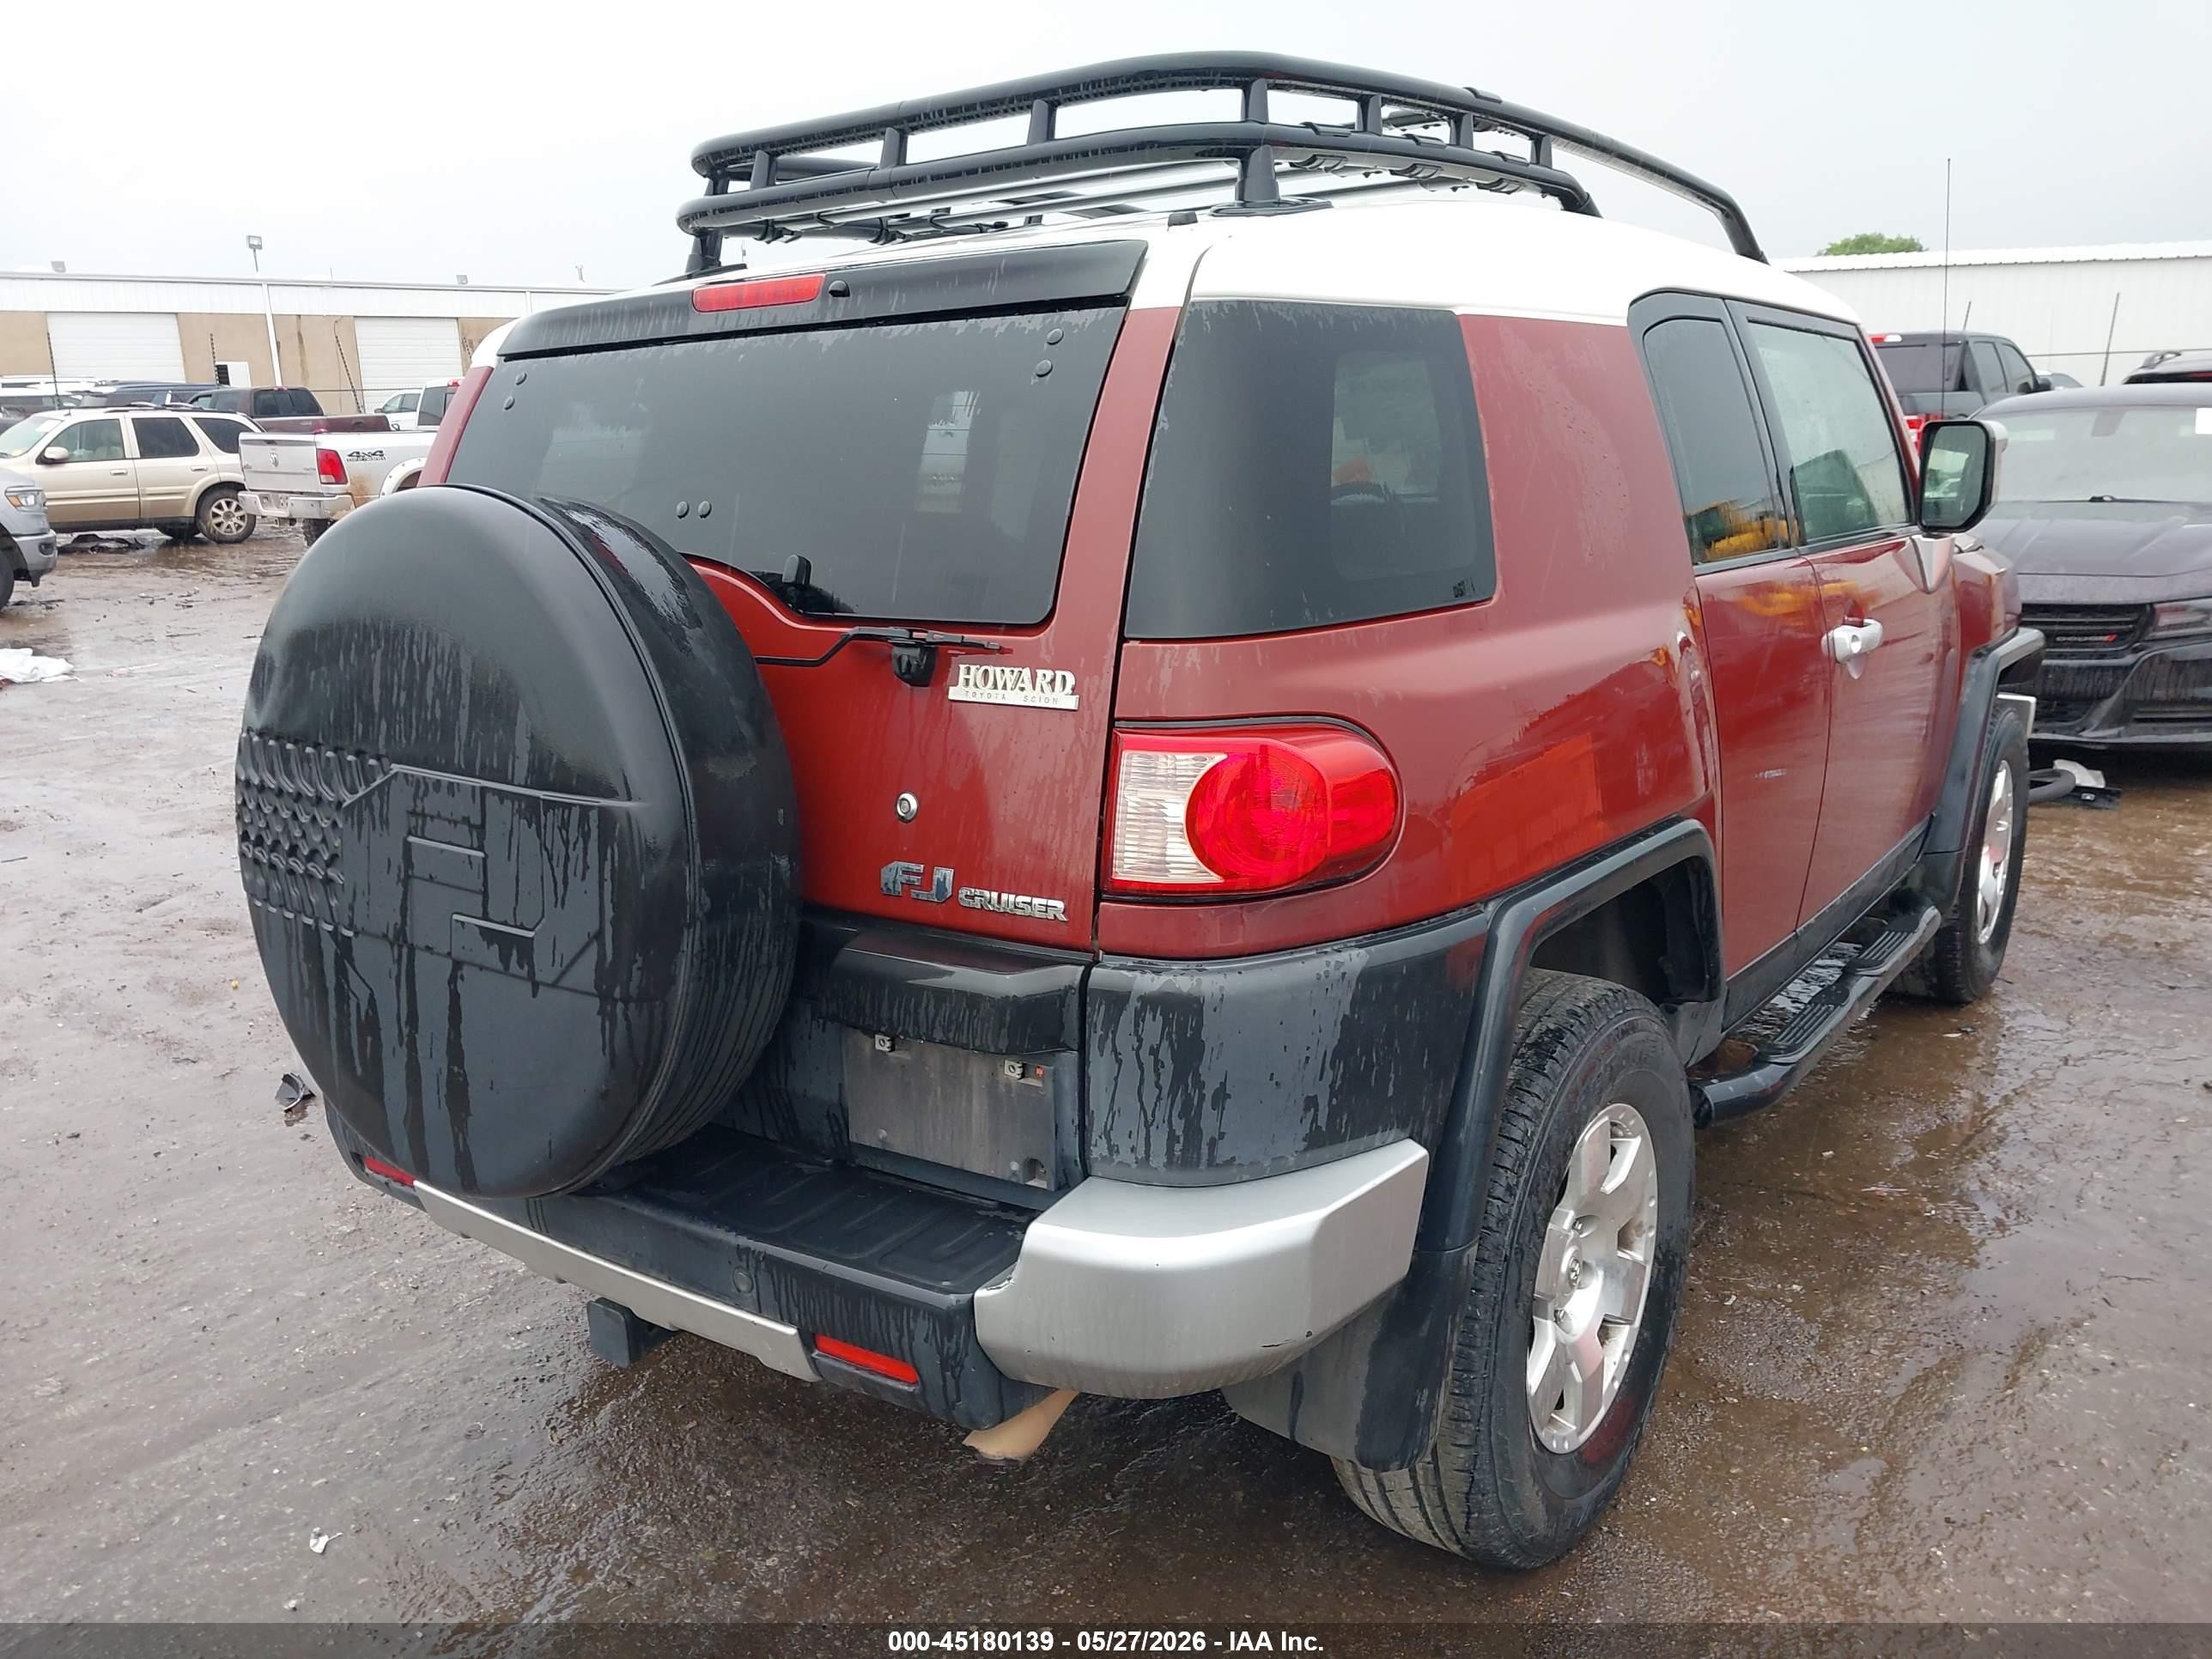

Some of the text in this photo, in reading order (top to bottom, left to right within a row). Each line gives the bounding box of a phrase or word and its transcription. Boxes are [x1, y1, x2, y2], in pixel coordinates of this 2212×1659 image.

[958, 664, 1076, 696] HOWARD
[965, 690, 1059, 704] TOYOTA SCION
[880, 860, 1069, 921] FJ CRUISER
